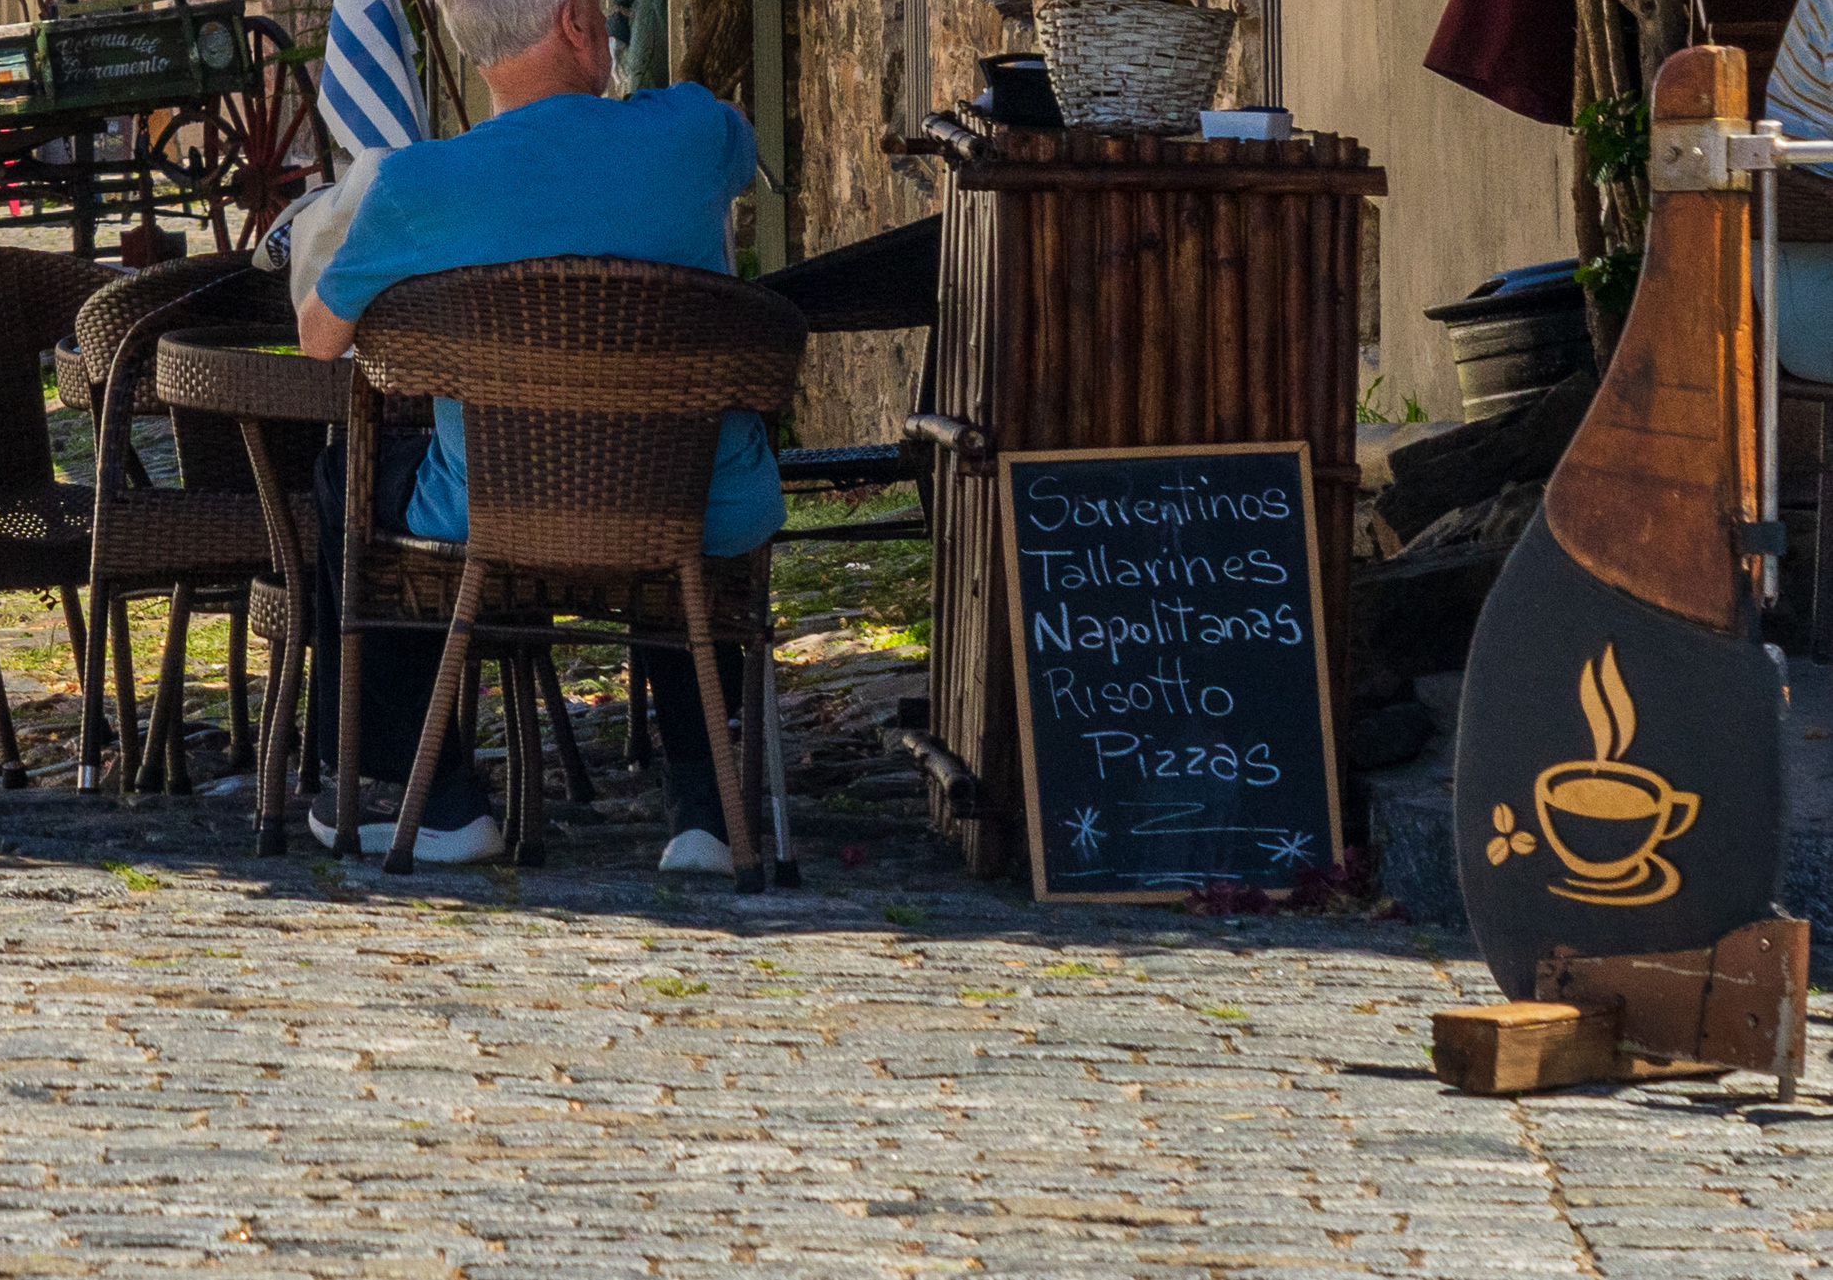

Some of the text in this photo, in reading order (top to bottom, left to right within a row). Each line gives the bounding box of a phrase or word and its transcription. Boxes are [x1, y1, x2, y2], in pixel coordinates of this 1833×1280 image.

[1029, 475, 1290, 531] Sorrentinos
[1021, 545, 1287, 591] Tallarines
[1034, 598, 1302, 664] Napolitanas
[1042, 657, 1233, 718] Risotto
[1081, 731, 1280, 785] Pizzas
